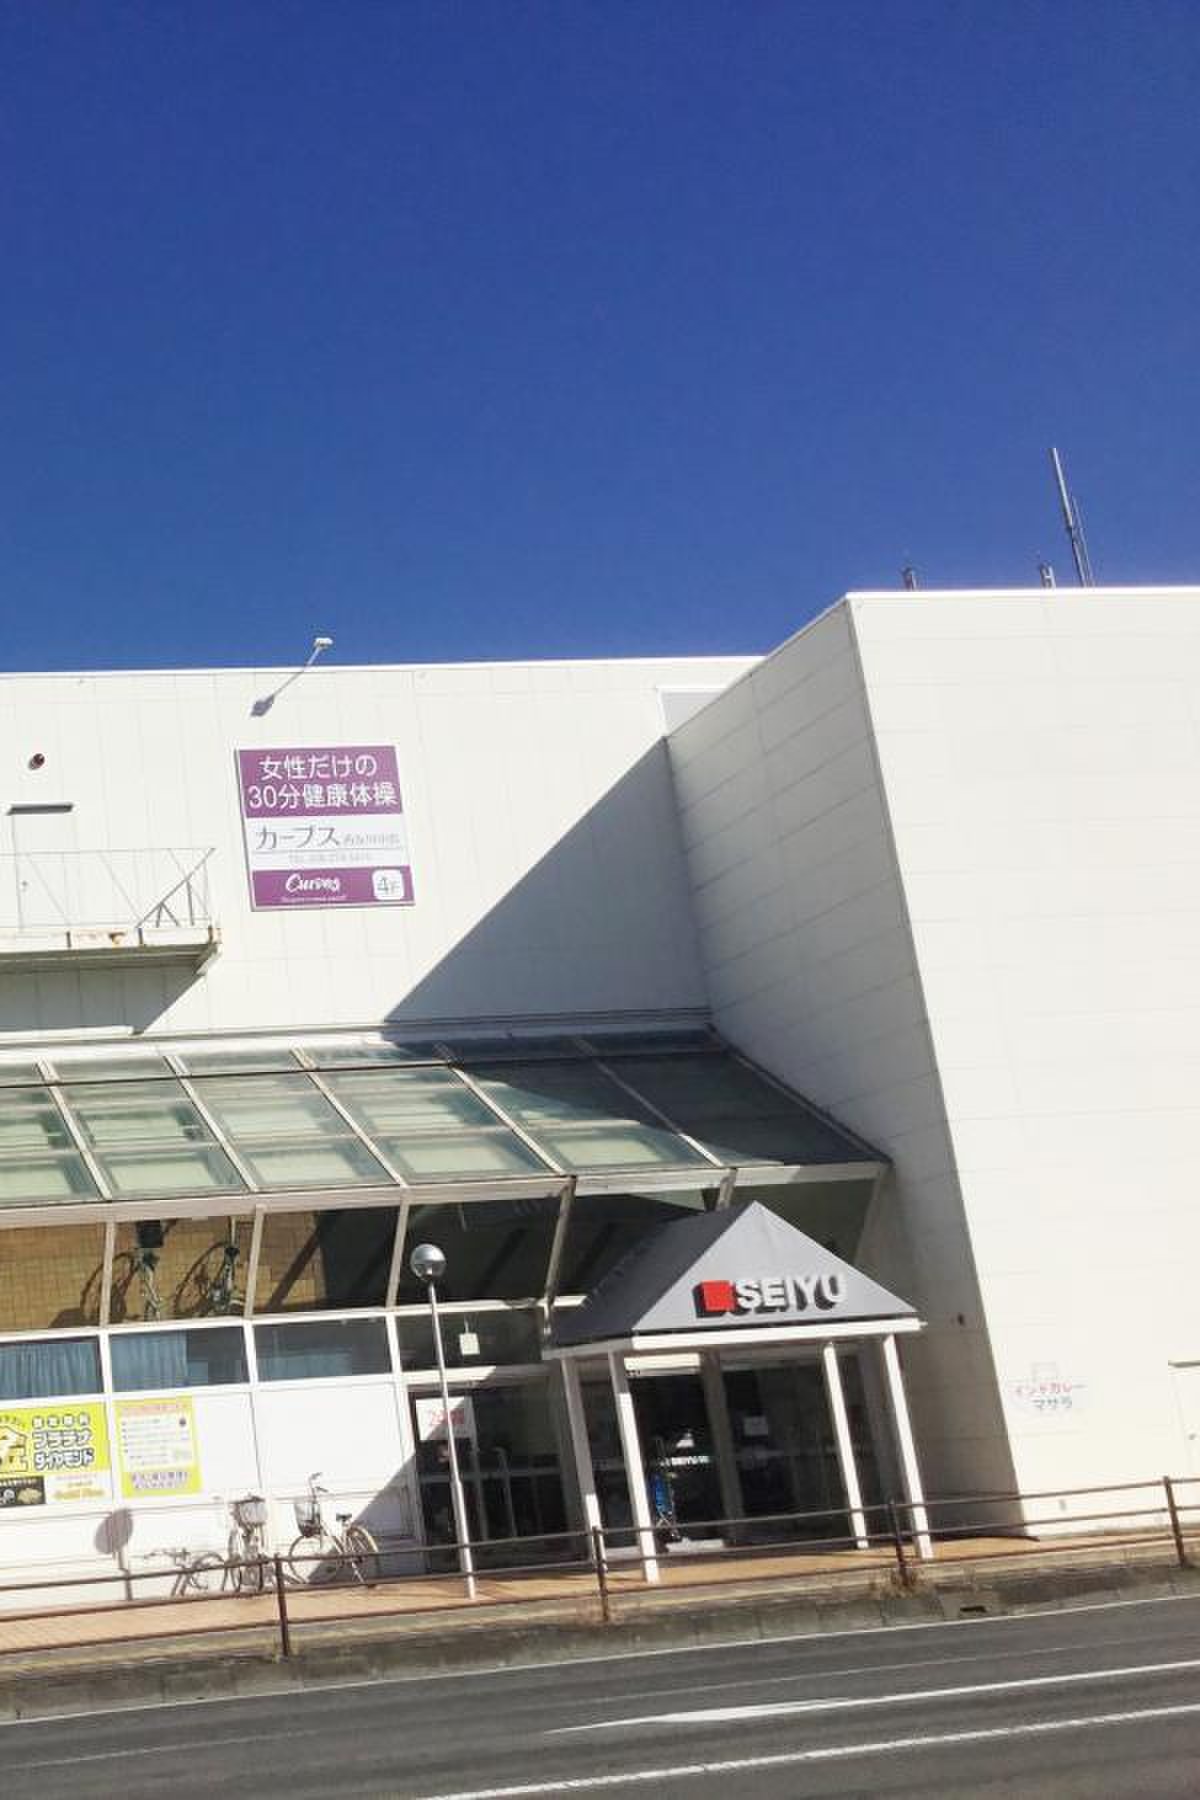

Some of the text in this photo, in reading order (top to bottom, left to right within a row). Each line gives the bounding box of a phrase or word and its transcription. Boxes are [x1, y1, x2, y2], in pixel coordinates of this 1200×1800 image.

[259, 754, 377, 781] 女性だけの
[248, 782, 398, 809] 30分健康体操
[735, 1273, 847, 1310] SEIYU
